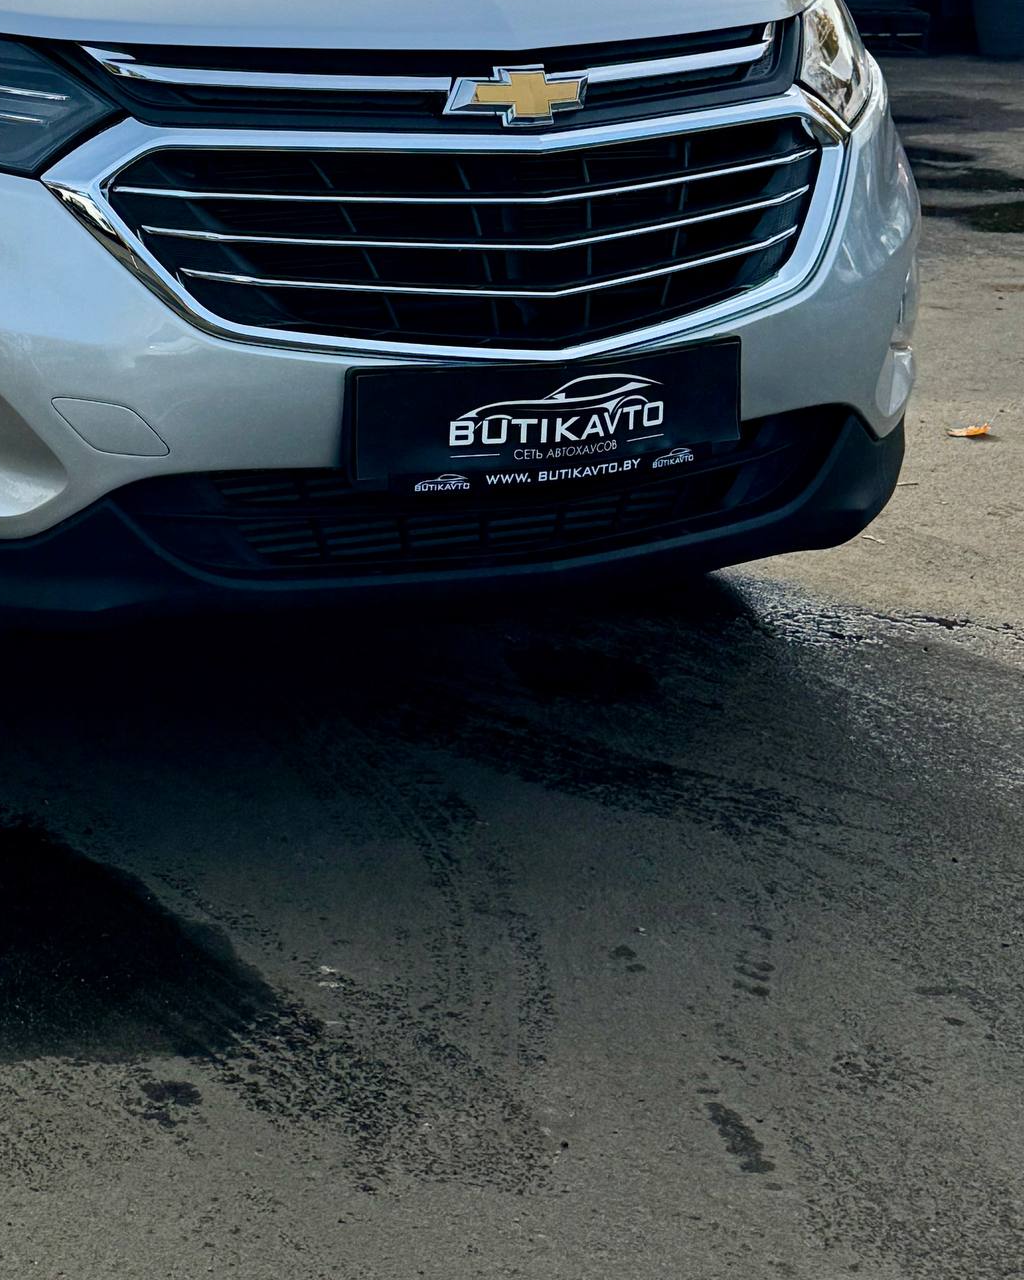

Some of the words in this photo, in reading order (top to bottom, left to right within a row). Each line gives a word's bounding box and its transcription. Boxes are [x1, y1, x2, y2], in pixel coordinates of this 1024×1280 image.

[448, 400, 664, 446] BUTIKAVTO
[513, 448, 543, 460] СЕТЬ
[545, 439, 618, 459] АВТОХАУСОВ
[485, 472, 532, 485] WWW.
[538, 458, 641, 482] BUTIKAVTO.BY
[652, 454, 695, 469] BUTIKAVTO
[414, 482, 471, 492] BUTIKAVTO
